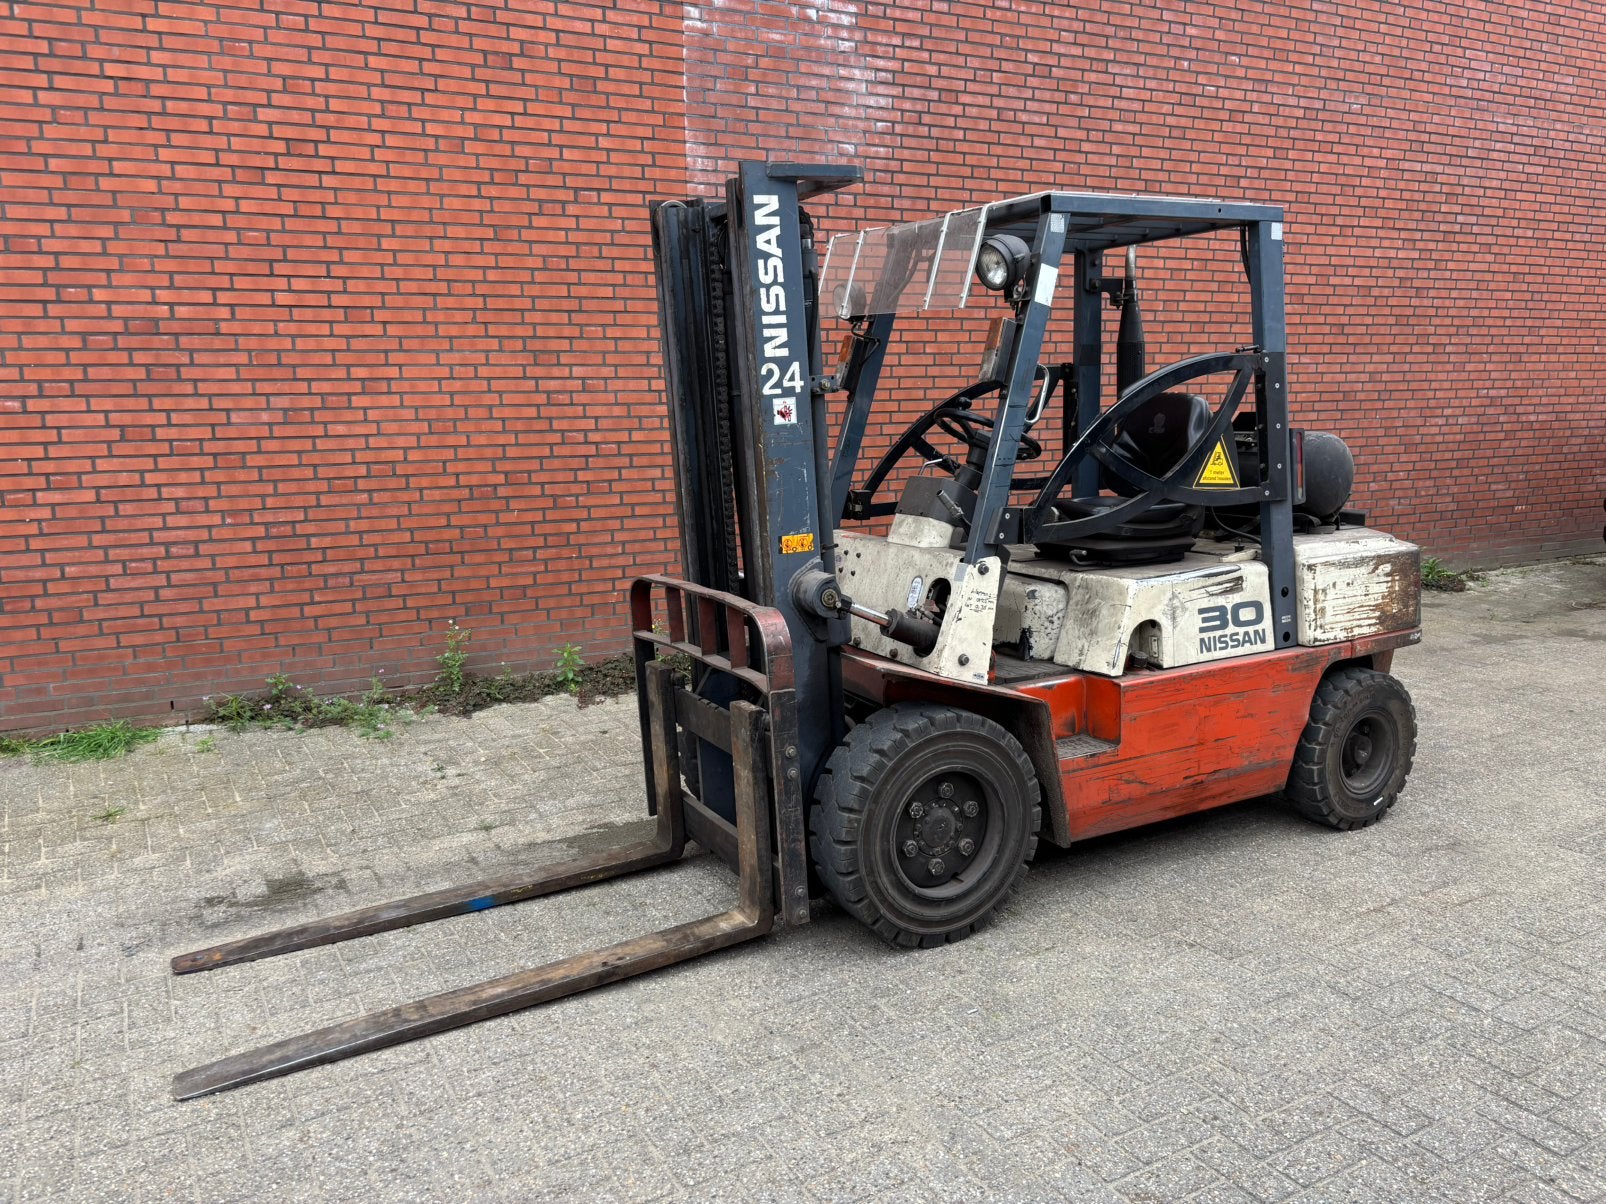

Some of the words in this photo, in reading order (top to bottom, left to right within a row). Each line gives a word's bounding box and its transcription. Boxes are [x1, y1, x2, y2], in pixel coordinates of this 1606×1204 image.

[753, 195, 789, 357] NISSAN
[760, 361, 804, 395] 24
[1197, 600, 1264, 633] 30
[1199, 628, 1267, 654] NISSAN
